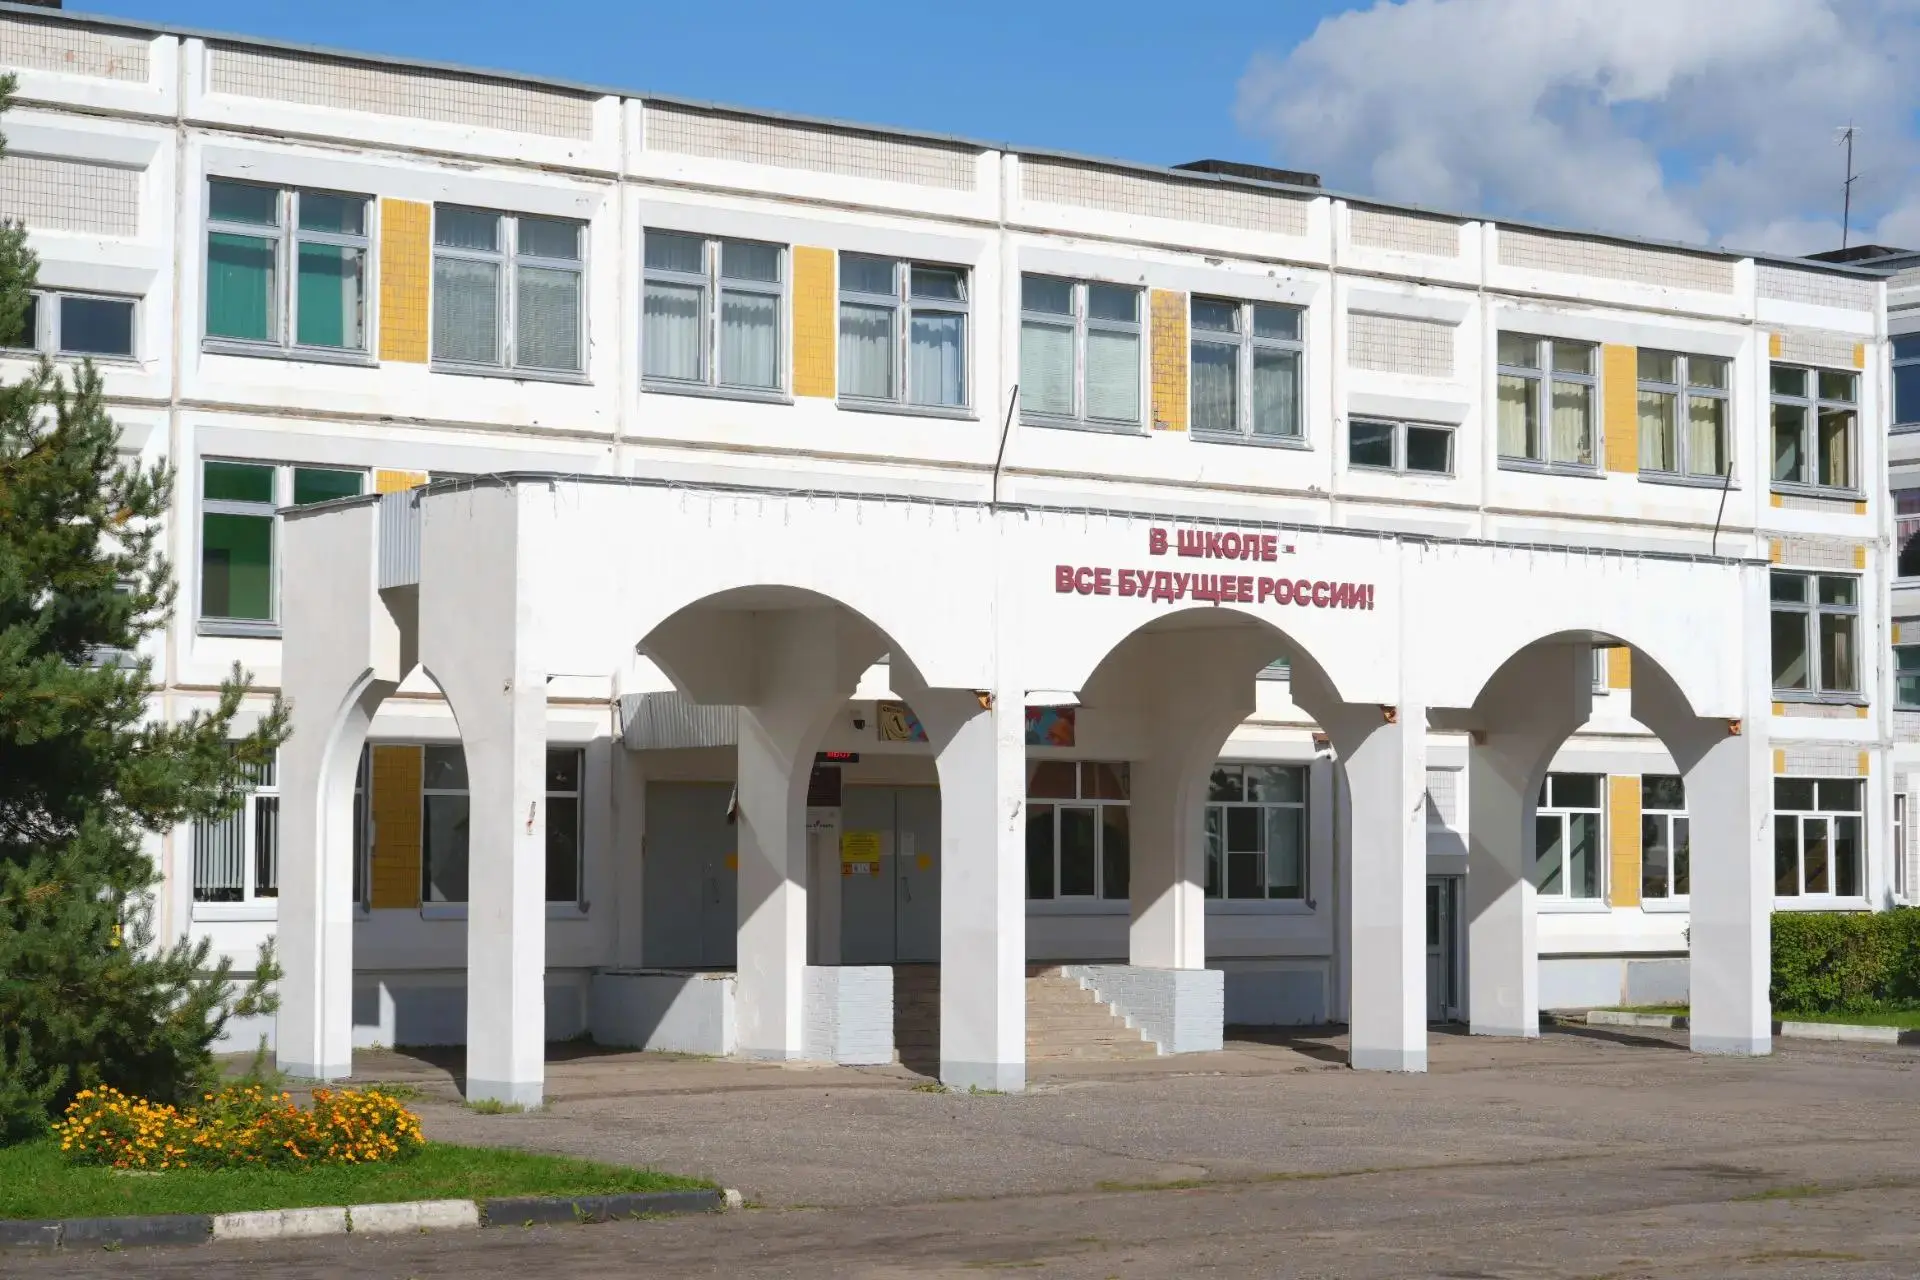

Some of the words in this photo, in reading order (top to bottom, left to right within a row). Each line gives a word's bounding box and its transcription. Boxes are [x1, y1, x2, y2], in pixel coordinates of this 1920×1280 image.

[1149, 528, 1168, 555] В
[1177, 529, 1277, 562] ШКОЛЕ
[1056, 565, 1111, 595] ВСЕ
[1118, 569, 1254, 607] БУДУЩЕЕ
[1258, 577, 1374, 610] РОССИИ!
